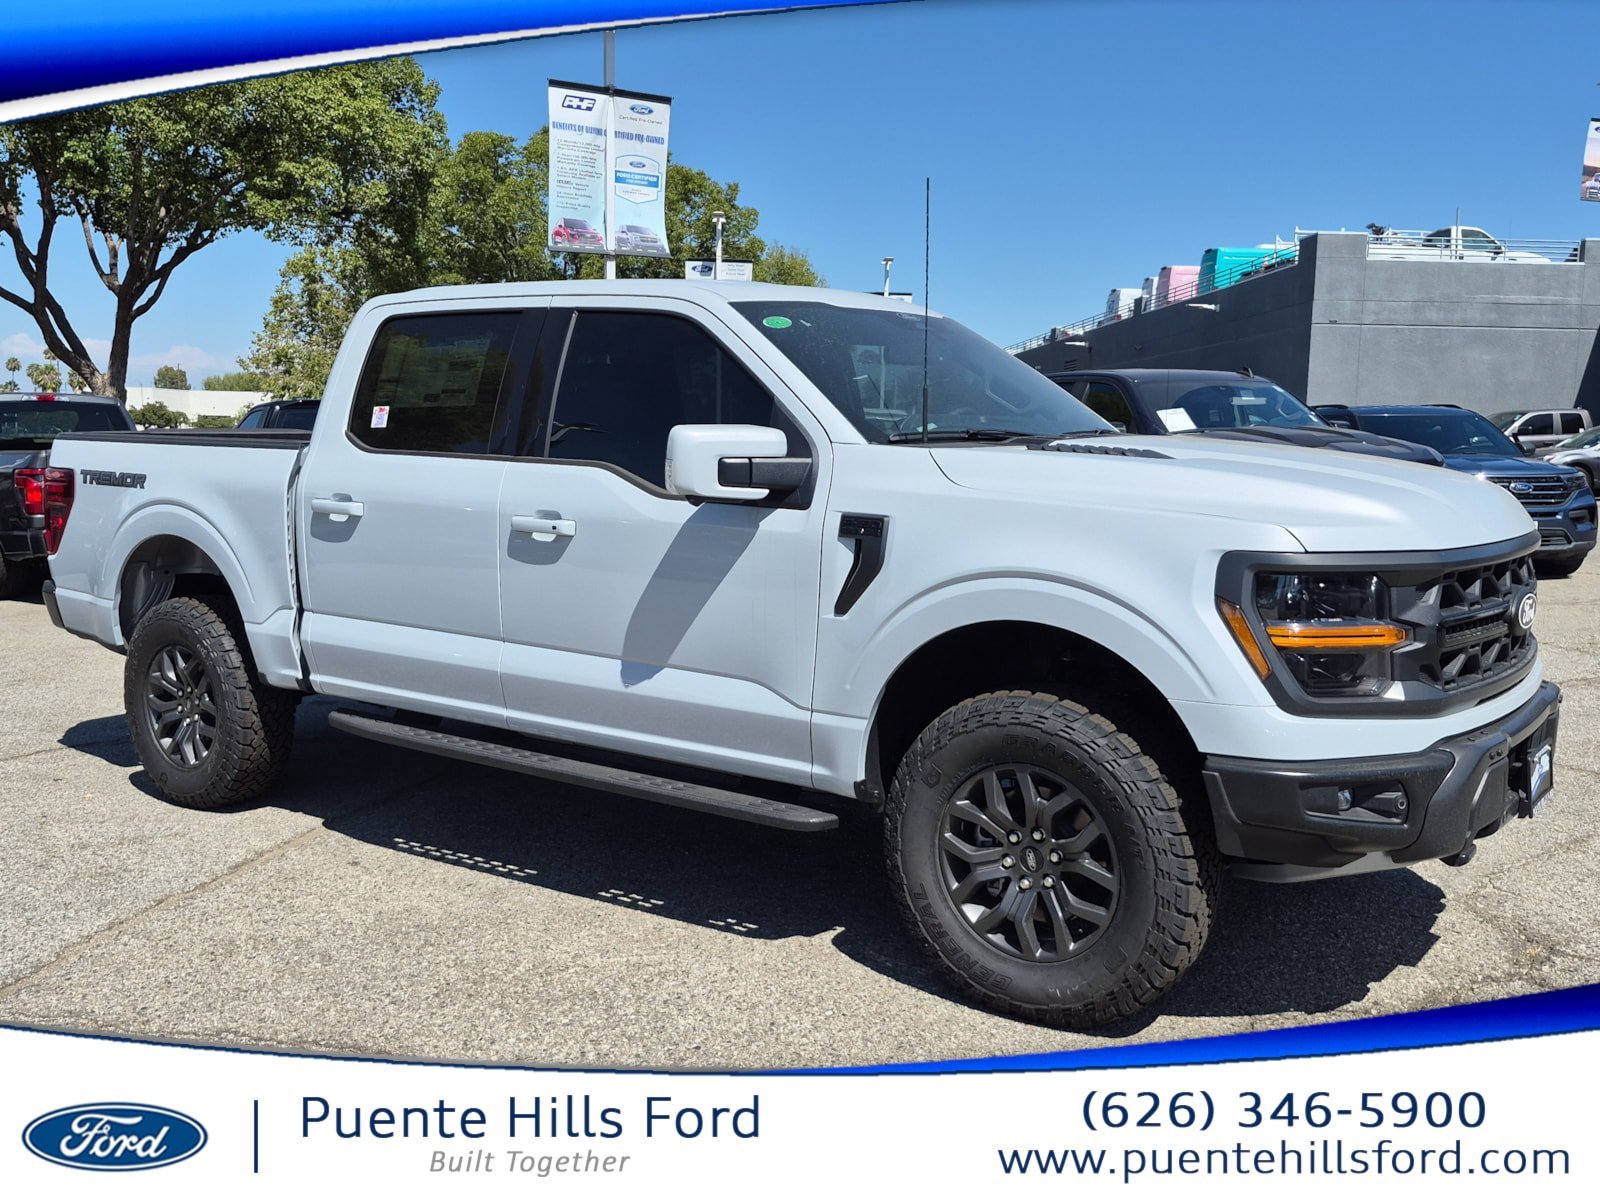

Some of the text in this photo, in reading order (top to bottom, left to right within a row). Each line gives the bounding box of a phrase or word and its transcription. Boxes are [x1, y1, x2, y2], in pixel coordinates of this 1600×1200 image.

[552, 121, 577, 132] BENEFITS
[577, 124, 584, 133] OF
[80, 468, 147, 489] TREMOR
[911, 881, 1015, 992] GENERAL
